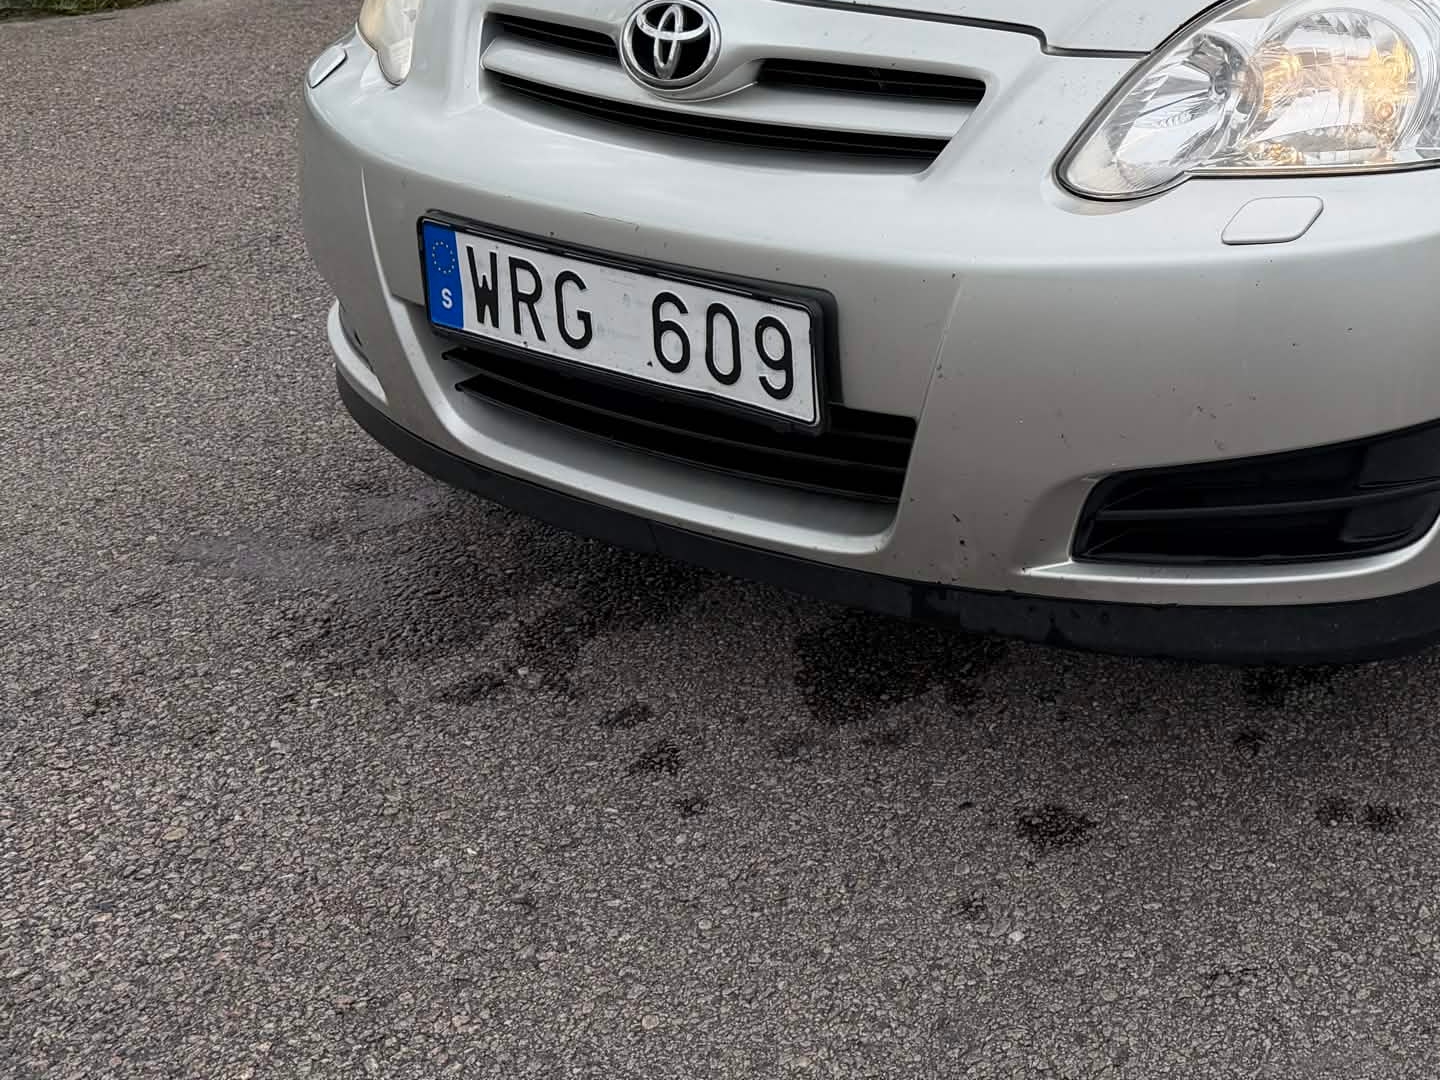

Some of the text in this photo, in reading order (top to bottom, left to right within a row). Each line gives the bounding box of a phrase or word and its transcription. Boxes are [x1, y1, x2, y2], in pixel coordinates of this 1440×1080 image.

[441, 287, 453, 310] S
[467, 246, 794, 400] WRG 609
